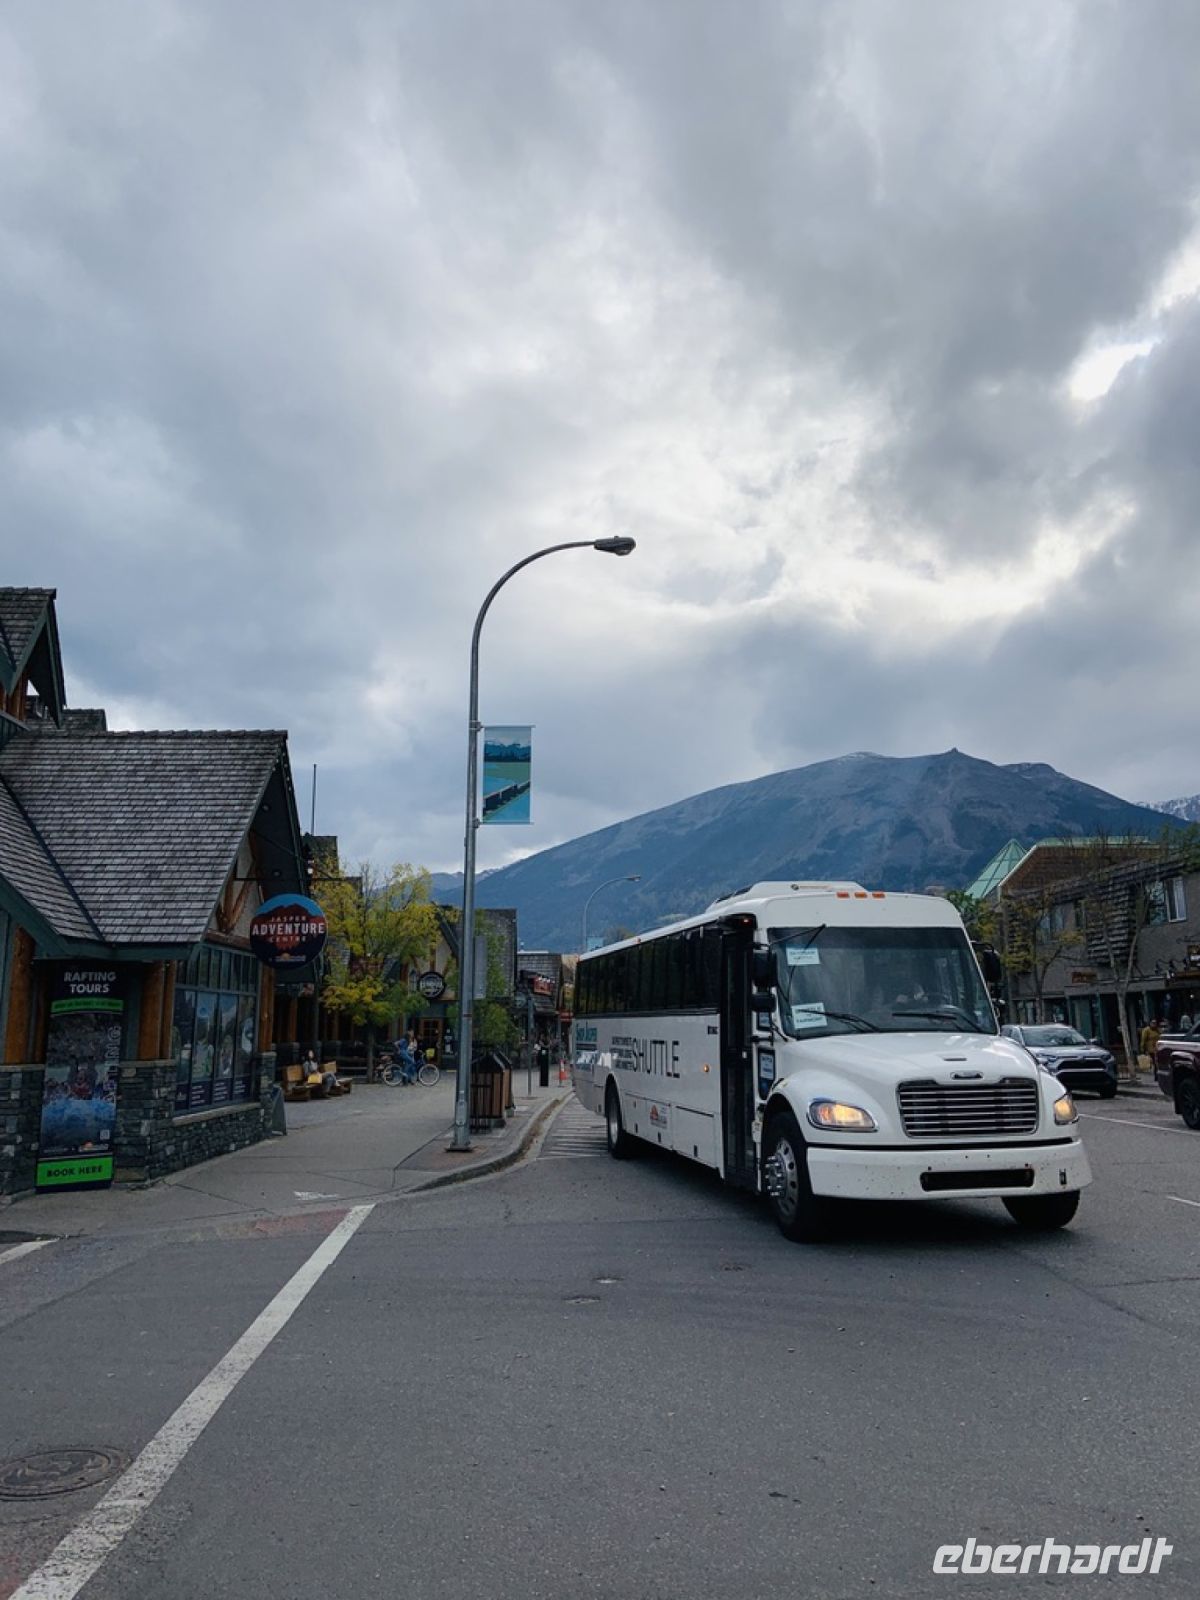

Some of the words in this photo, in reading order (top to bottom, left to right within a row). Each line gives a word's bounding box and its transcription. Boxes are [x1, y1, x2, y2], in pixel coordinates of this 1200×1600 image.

[252, 922, 326, 936] ADVENTURE
[63, 971, 117, 982] RAFTING
[69, 983, 111, 994] TOURS
[632, 1036, 680, 1079] SHUTTLE
[46, 1167, 75, 1178] BOOK
[79, 1165, 103, 1175] HERE
